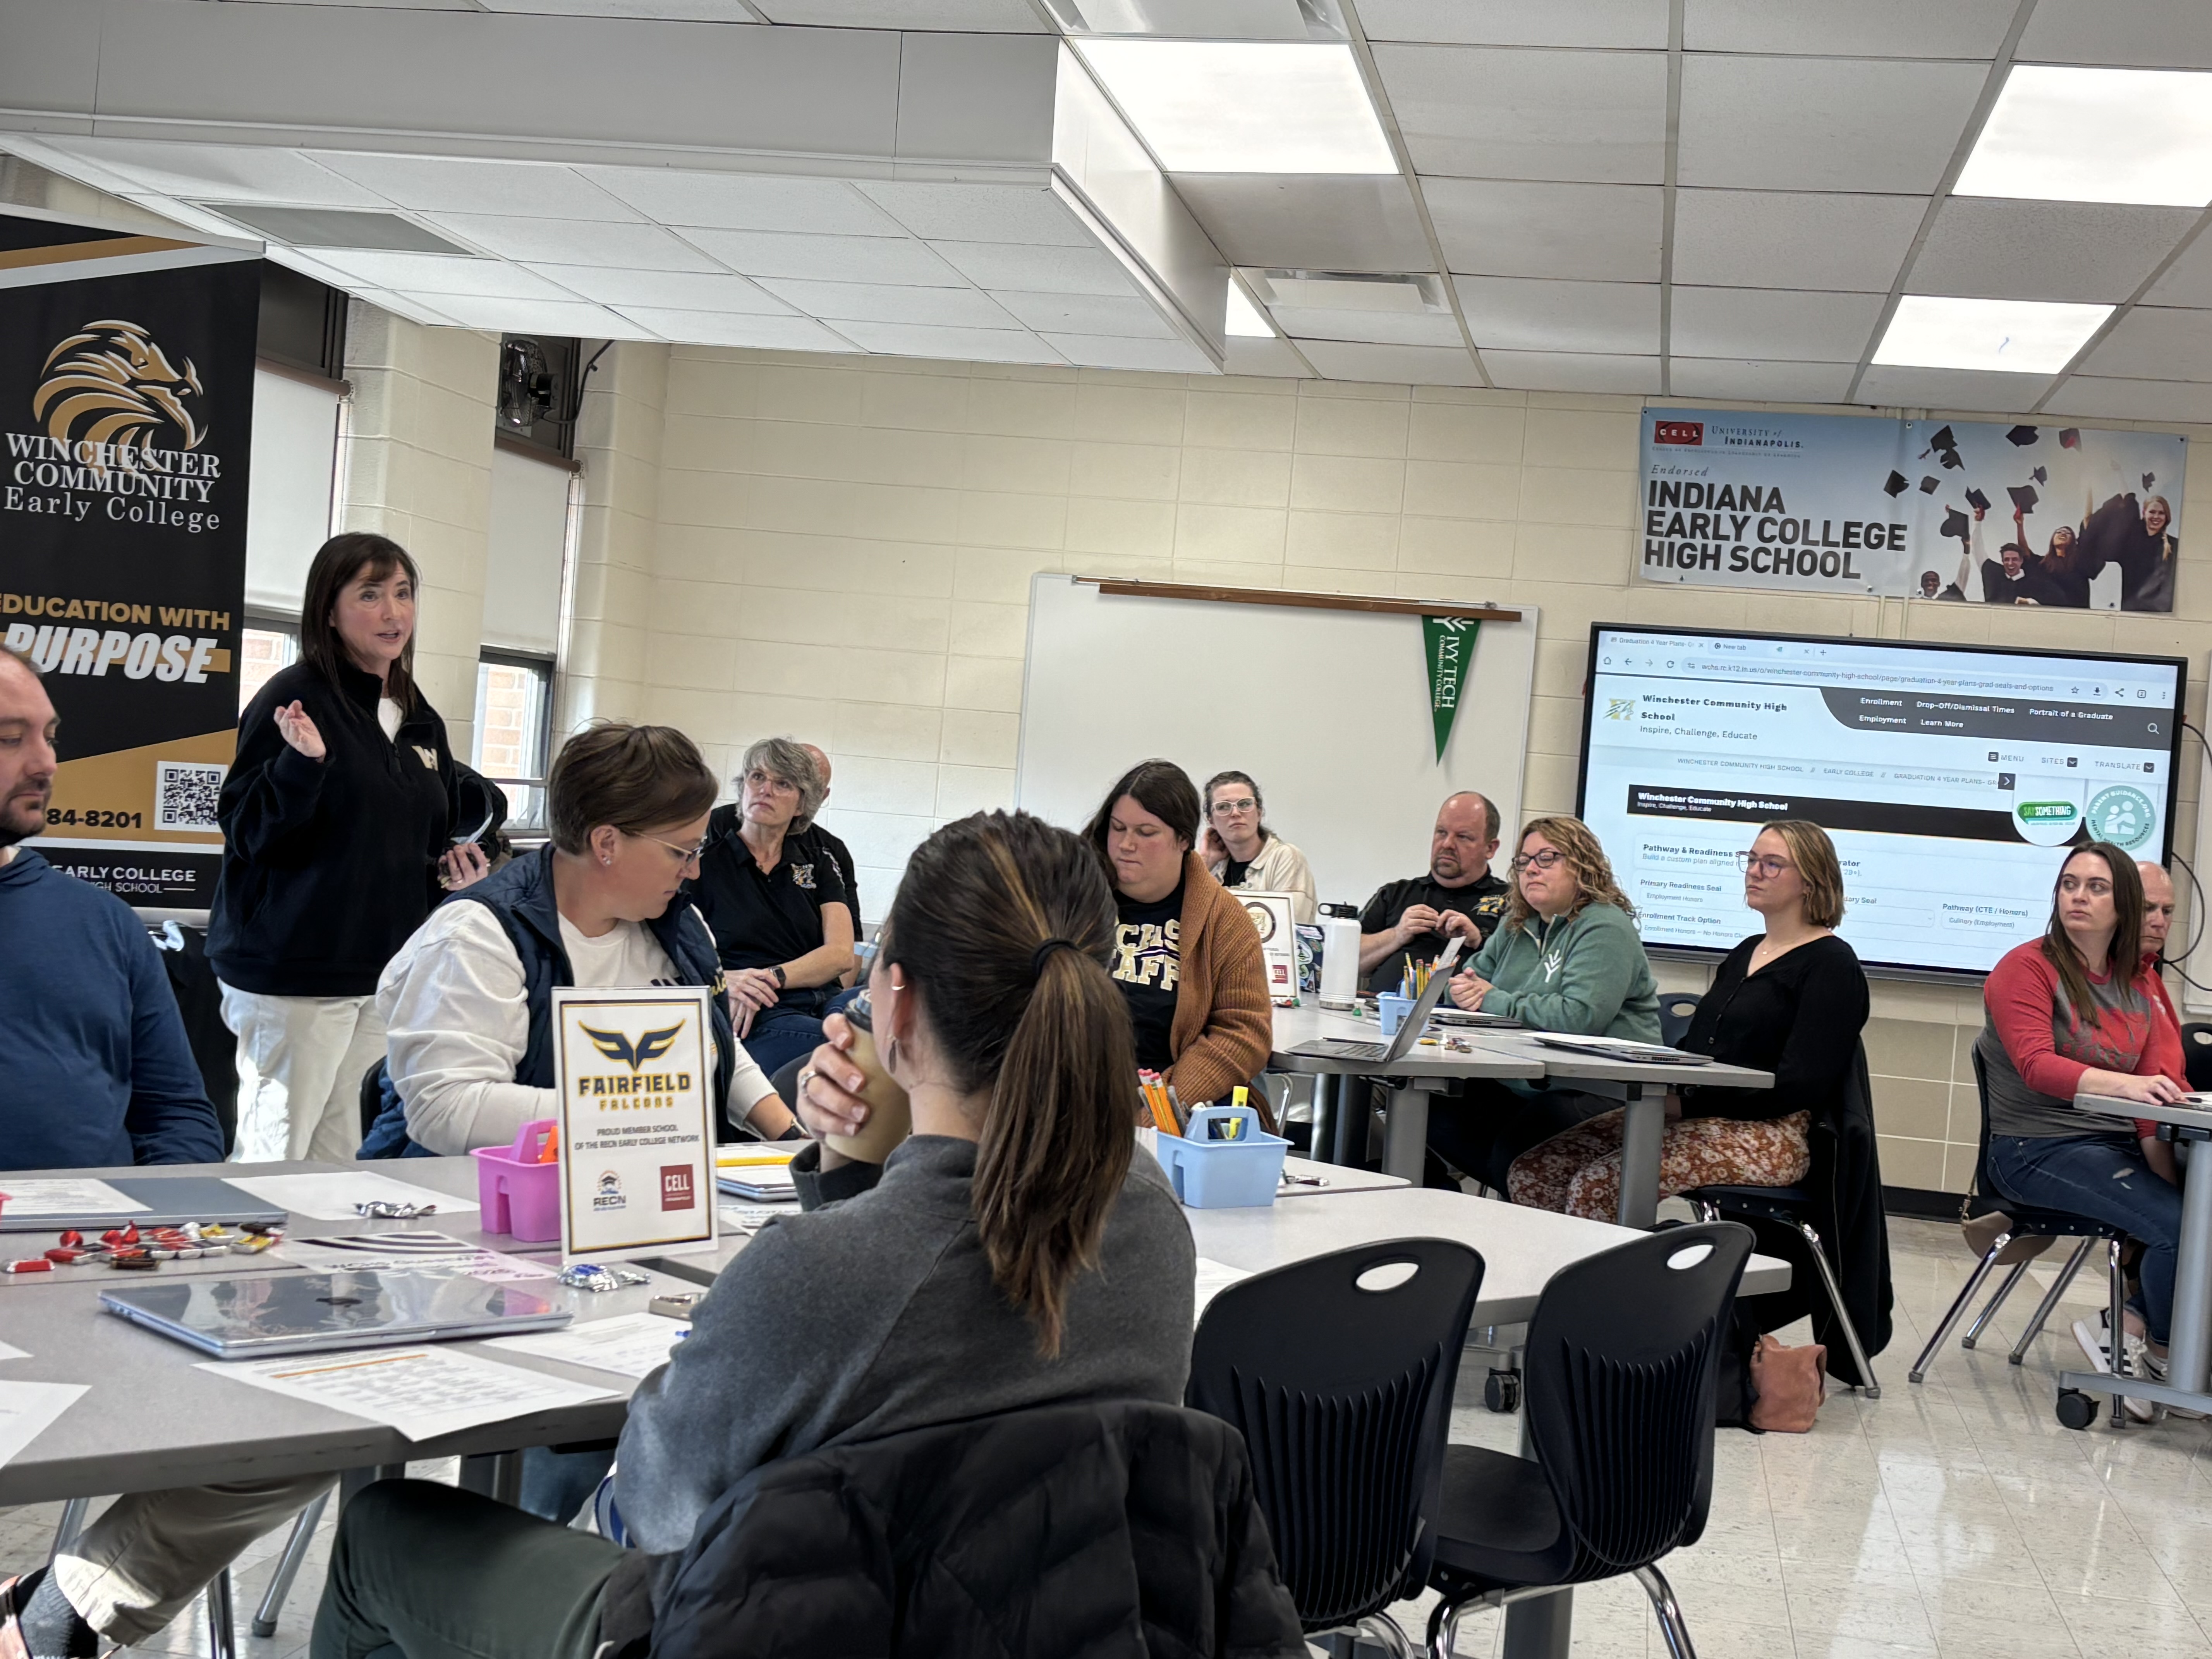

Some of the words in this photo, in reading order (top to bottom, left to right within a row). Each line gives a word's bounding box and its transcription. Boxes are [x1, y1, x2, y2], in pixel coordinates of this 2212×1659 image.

[1659, 428, 1698, 437] CELL
[1712, 426, 1769, 436] UNIVERSITY
[5, 433, 221, 478] WINCHESTER
[1651, 465, 1709, 477] Endorsed
[14, 460, 215, 503] COMMUNITY
[1648, 480, 1786, 514] INDIANA
[4, 486, 91, 522] Early
[106, 496, 220, 533] College
[1646, 510, 1751, 542] EARLY
[1757, 516, 1907, 551] COLLEGE
[1645, 539, 1722, 571] HIGH
[1728, 545, 1861, 580] SCHOOL
[0, 593, 151, 625] DUCATION
[159, 606, 230, 631] WITH
[3, 622, 218, 684] PURPOSE
[1437, 635, 1446, 678] COMMUNITY
[1445, 636, 1460, 663] IVY
[1441, 666, 1458, 708] TECH
[1643, 694, 1700, 706] Winchester
[1704, 697, 1761, 711] Community
[1764, 702, 1787, 712] High
[1860, 697, 1903, 707] Enrollment
[1917, 701, 1990, 713] Drop-Off/Dismissal
[1992, 706, 2015, 714] Times
[2030, 708, 2059, 717] Portrait
[2078, 712, 2114, 721] Graduate
[1641, 711, 1676, 721] School
[1859, 715, 1907, 725] Employment
[1920, 719, 1943, 727] Learn
[1945, 720, 1964, 729] More
[1640, 725, 1671, 735] Inspire,
[1674, 728, 1719, 738] Challenge,
[1722, 731, 1757, 740] Educate
[2001, 754, 2024, 763] MENU
[2041, 757, 2064, 765] SITES
[2095, 761, 2141, 771] TRANSLATE
[1678, 758, 1719, 766] WINCHESTER
[1721, 760, 1759, 769] COMMUNITY
[1778, 764, 1803, 772] SCHOOL
[1894, 773, 1936, 781] GRADUATION
[1638, 792, 1686, 804] Winchester
[1687, 795, 1736, 808] Community
[1737, 799, 1757, 809] High
[1758, 800, 1788, 811] School
[46, 808, 142, 828] 84-8201
[1643, 844, 1680, 854] Pathway
[1689, 847, 1733, 857] Readiness
[112, 867, 196, 882] COLLEGE
[115, 882, 164, 893] SCHOOL
[1640, 879, 1668, 889] Primary
[1669, 881, 1704, 890] Readiness
[1942, 903, 1973, 913] Pathway
[1638, 912, 1674, 921] Enrollment
[1698, 916, 1721, 924] Option
[1114, 918, 1181, 953] CHS
[1111, 948, 1181, 991] AFF
[578, 1072, 692, 1097] FAIRFIELD
[599, 1096, 674, 1112] FALCONS
[597, 1127, 620, 1137] PROUD
[622, 1125, 651, 1134] MEMBER
[653, 1124, 678, 1133] SCHOOL
[575, 1142, 584, 1151] OF
[586, 1141, 598, 1149] THE
[619, 1139, 637, 1148] EARLY
[639, 1137, 666, 1146] COLLEGE
[668, 1134, 700, 1145] NETWORK
[665, 1174, 690, 1192] CELL
[593, 1195, 626, 1206] RECN
